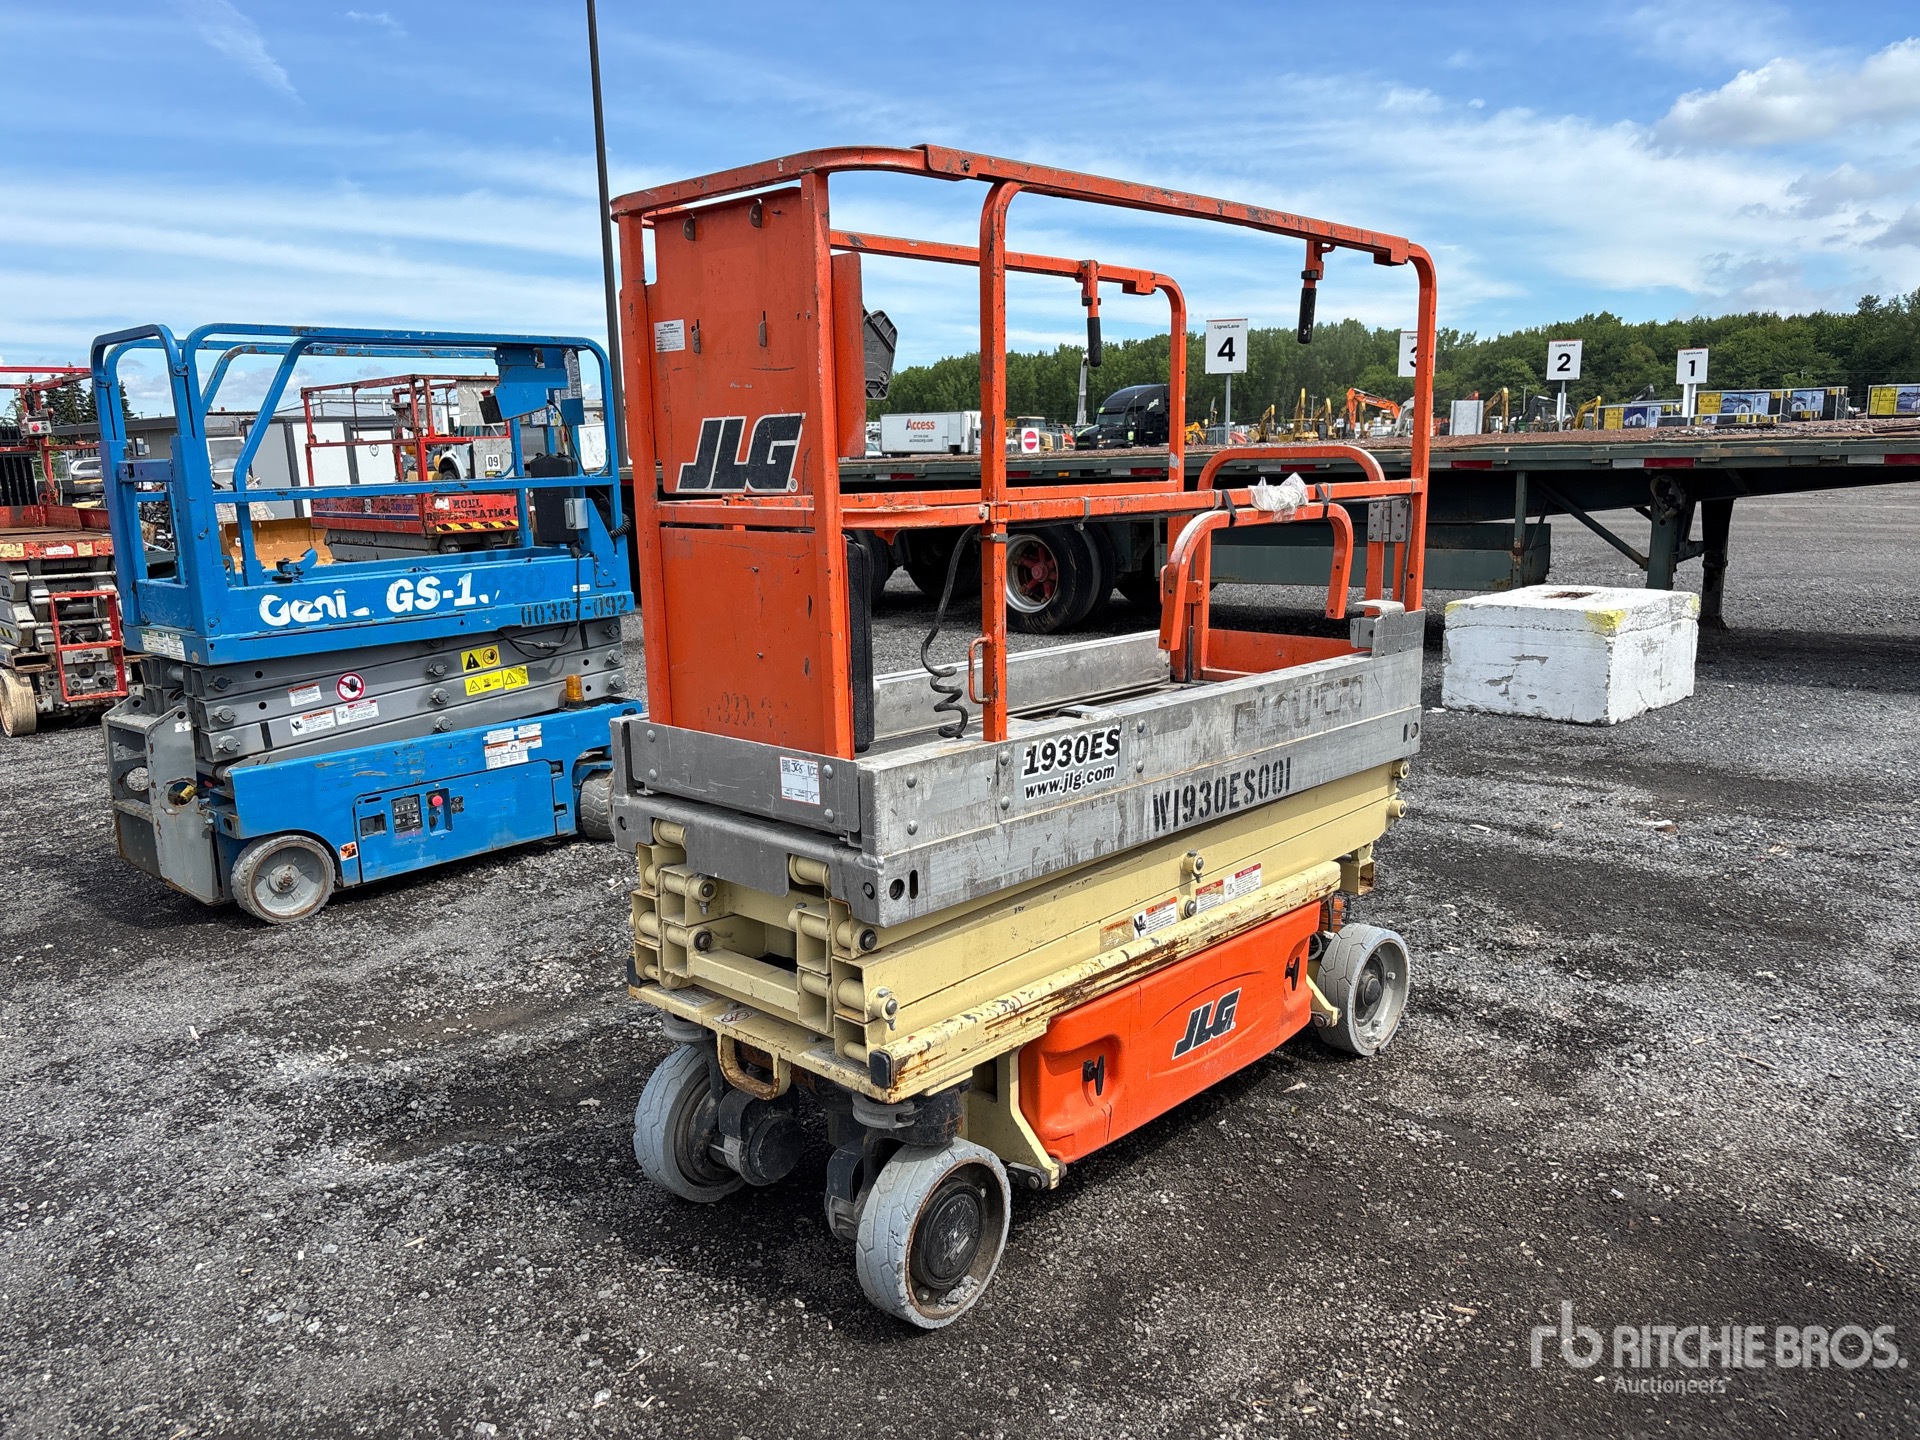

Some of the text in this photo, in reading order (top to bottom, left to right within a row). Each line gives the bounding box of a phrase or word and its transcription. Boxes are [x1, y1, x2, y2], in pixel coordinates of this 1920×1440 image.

[1217, 336, 1236, 362] 4
[1557, 352, 1571, 372] 2
[1688, 359, 1696, 377] 1
[905, 418, 936, 431] Access
[487, 456, 499, 467] 09
[676, 412, 806, 493] JLG
[1024, 728, 1121, 775] 1930ES
[1025, 766, 1115, 799] www.jlg.com
[1172, 987, 1242, 1060] JLG
